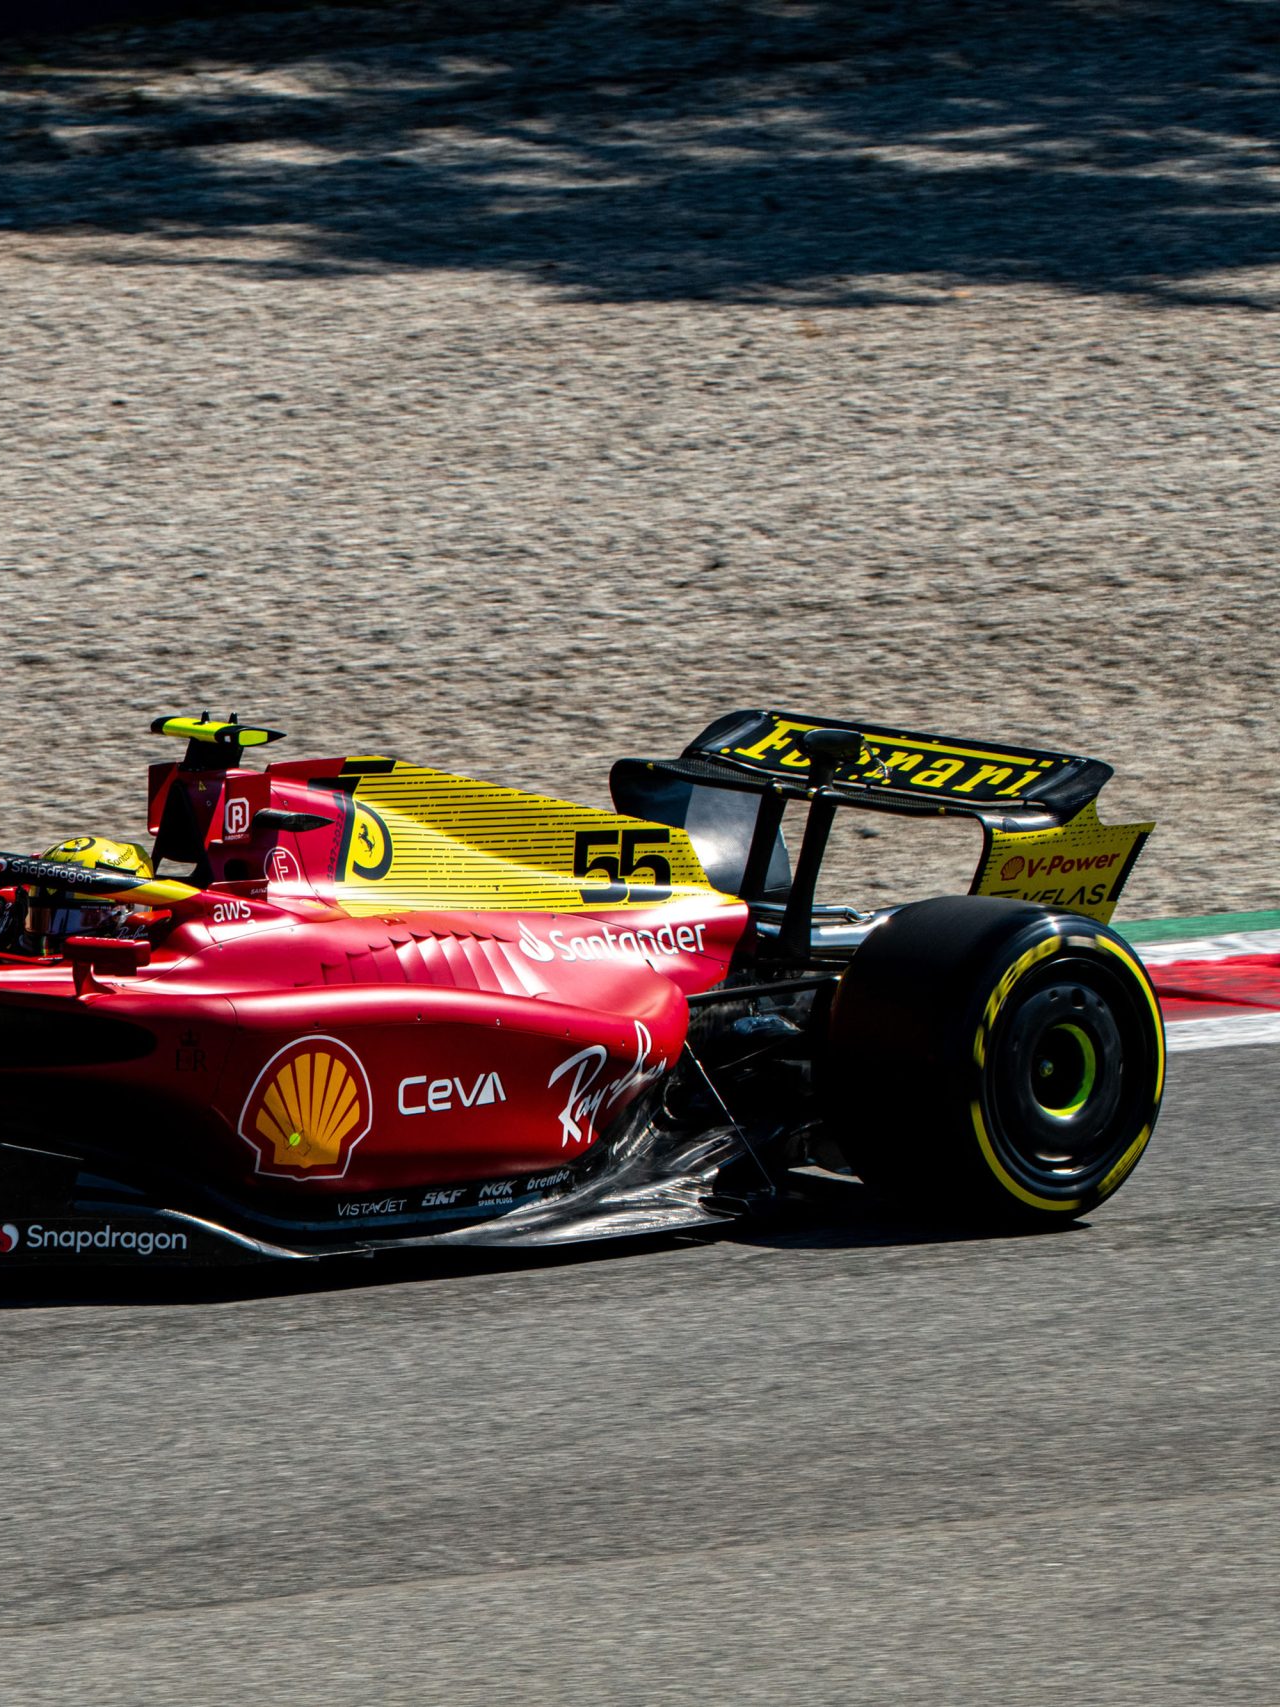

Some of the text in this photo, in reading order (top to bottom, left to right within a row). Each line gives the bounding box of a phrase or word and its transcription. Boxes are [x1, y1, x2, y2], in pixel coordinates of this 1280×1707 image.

[11, 860, 93, 884] Snapdragon
[574, 828, 673, 903] 55
[1027, 853, 1121, 878] V-Power
[213, 900, 252, 923] aws
[549, 922, 707, 962] Santander
[478, 1179, 519, 1199] NGK
[526, 1169, 571, 1191] brembo
[337, 1197, 408, 1217] VISTAJET
[421, 1188, 468, 1207] SKF
[26, 1224, 188, 1256] Snapdragon
